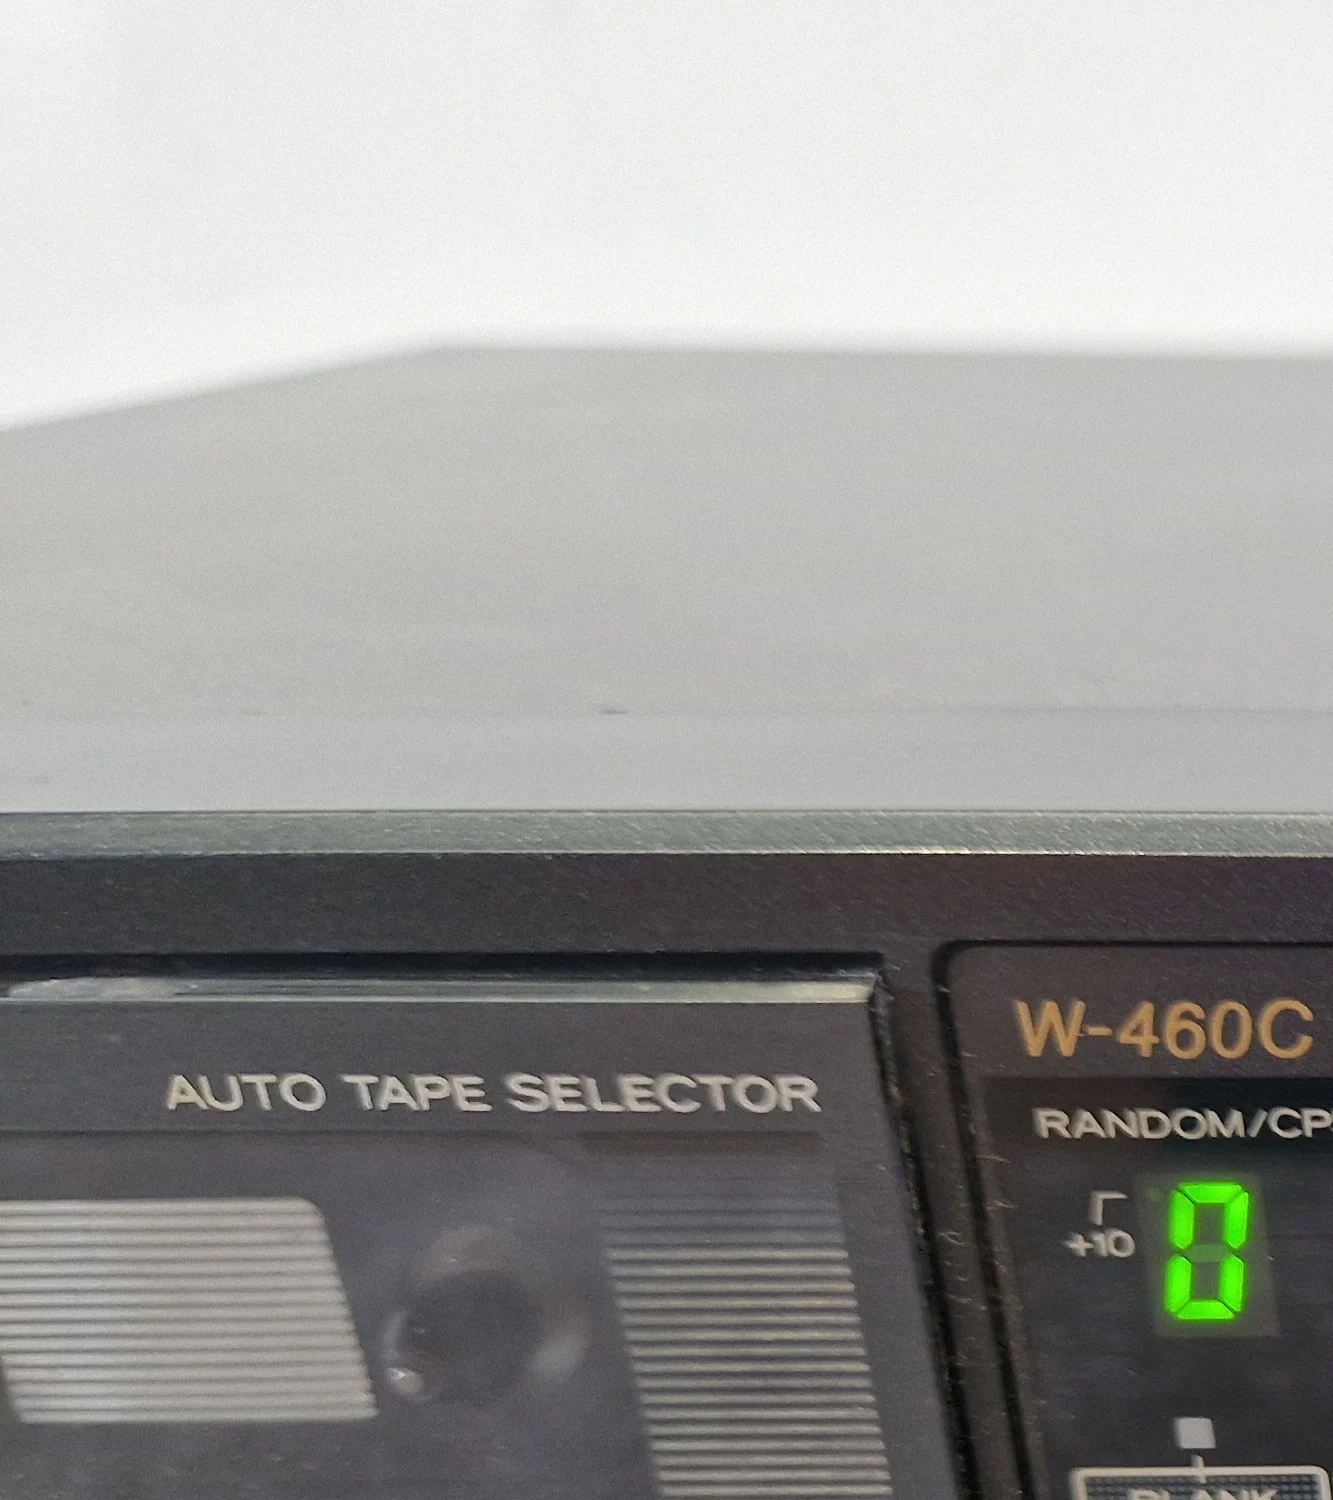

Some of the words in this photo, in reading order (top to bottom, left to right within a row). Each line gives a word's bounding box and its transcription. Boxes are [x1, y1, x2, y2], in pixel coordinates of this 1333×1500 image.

[1015, 1000, 1315, 1058] W-460C
[165, 1073, 328, 1113] AUTO
[342, 1073, 493, 1113] TAPE
[505, 1073, 822, 1114] SELECTOR
[1067, 1229, 1137, 1260] +10
[1163, 1180, 1252, 1322] 0
